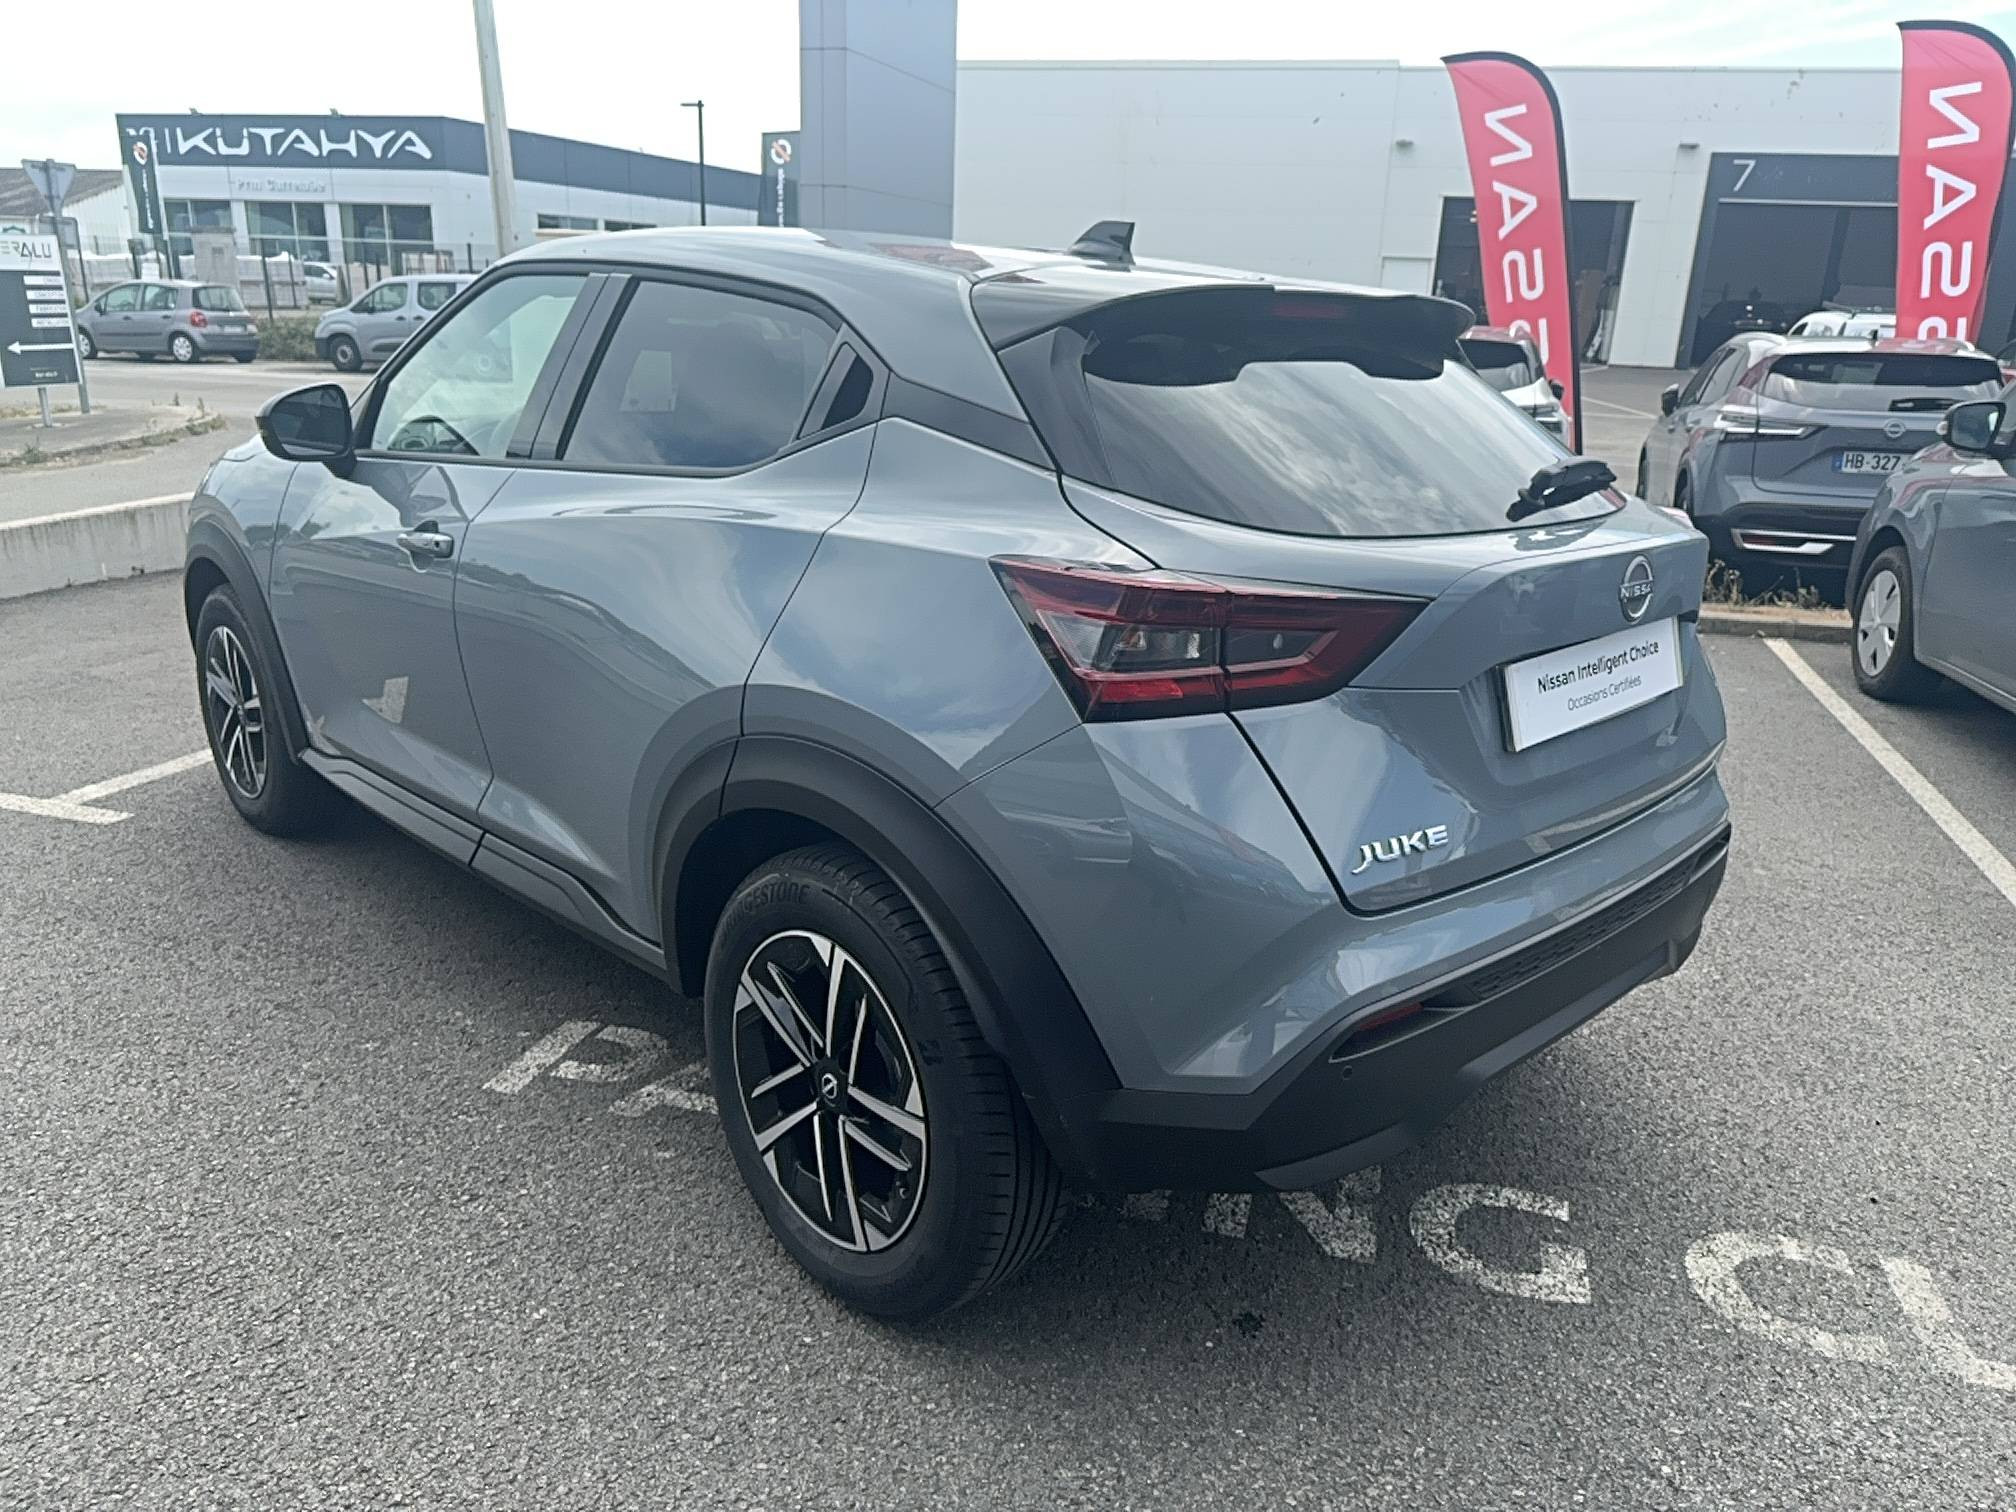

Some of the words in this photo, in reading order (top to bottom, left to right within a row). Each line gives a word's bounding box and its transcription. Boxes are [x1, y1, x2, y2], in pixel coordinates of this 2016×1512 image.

[1733, 159, 1757, 192] 7
[1537, 669, 1576, 695] Nissan
[1577, 650, 1629, 682] Intelligent
[1629, 639, 1660, 664] Choice
[1567, 687, 1610, 712] Occasions
[1351, 824, 1449, 874] JUKE
